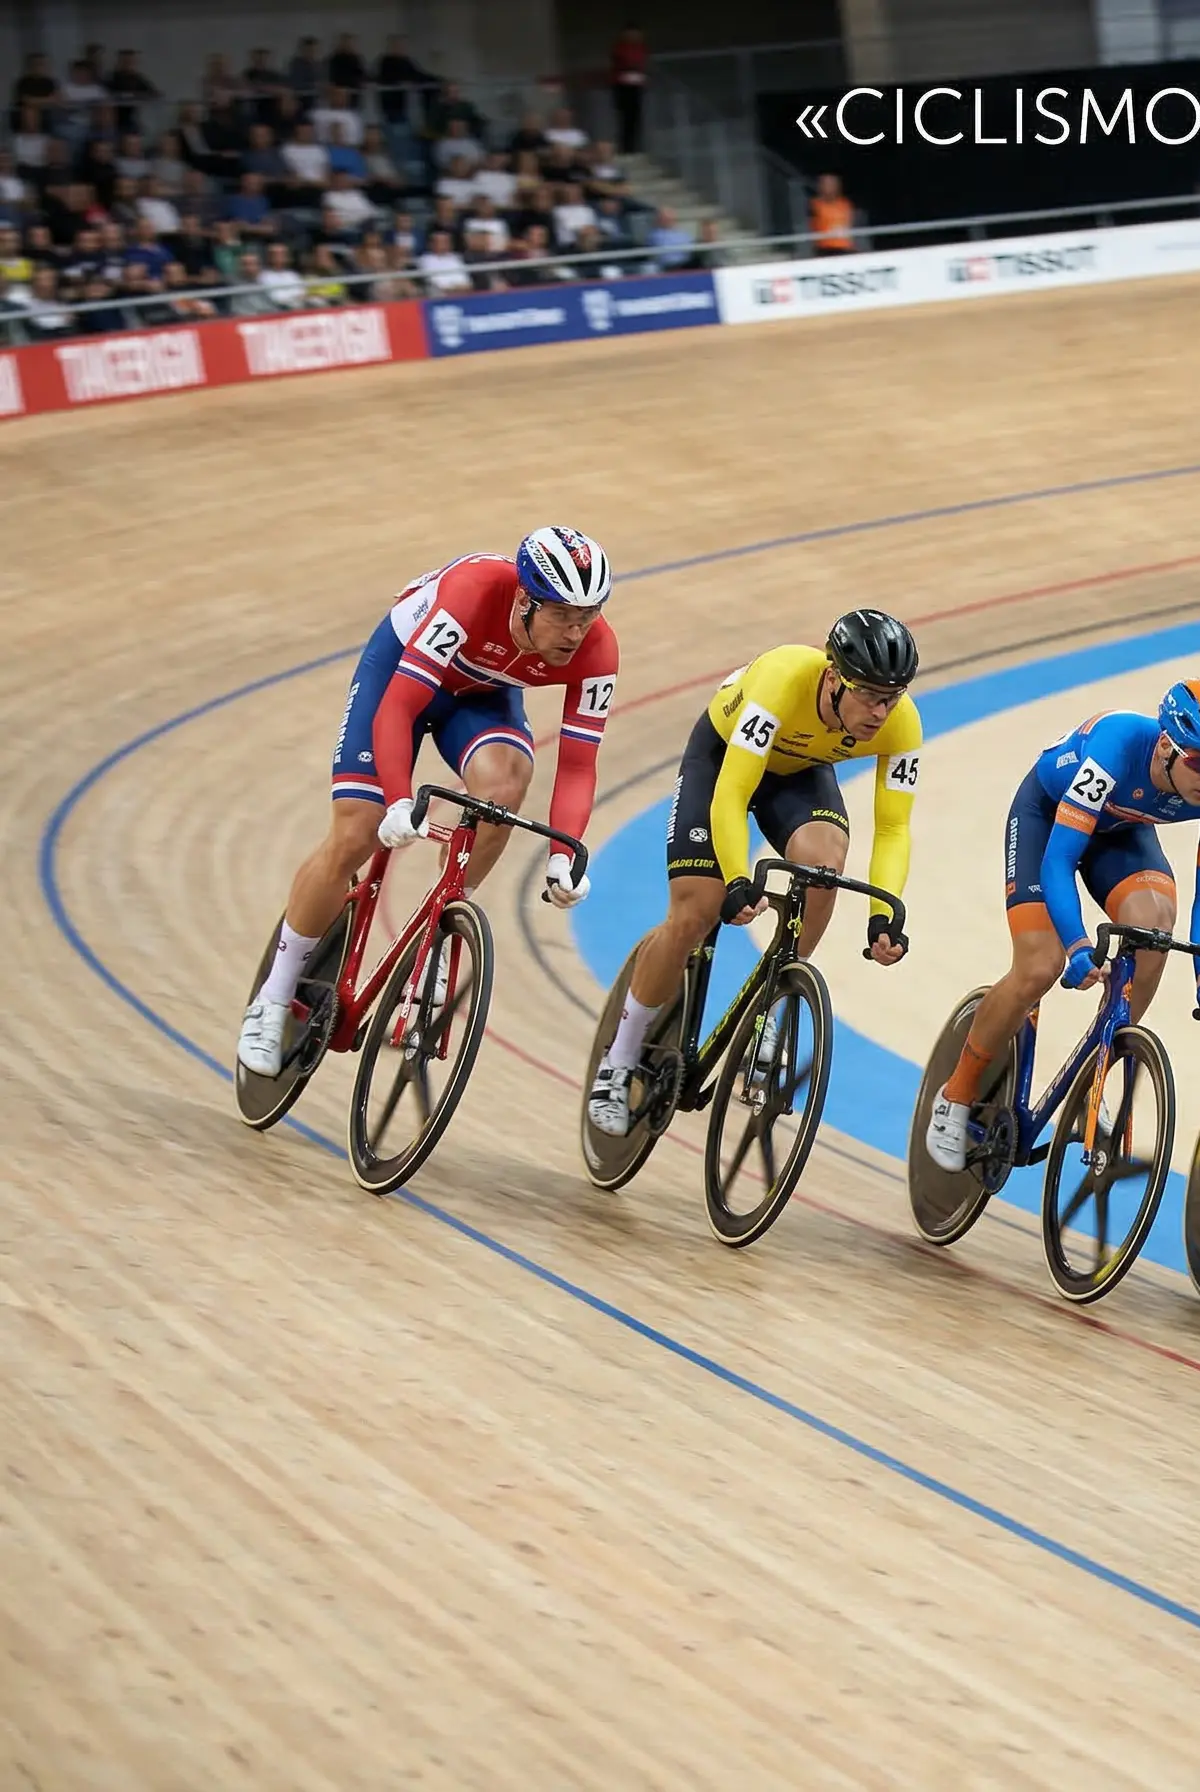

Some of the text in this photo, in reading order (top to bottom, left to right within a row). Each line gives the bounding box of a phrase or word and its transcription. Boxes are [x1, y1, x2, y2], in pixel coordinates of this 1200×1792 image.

[988, 245, 1098, 276] TISSOT
[793, 266, 897, 298] TISSOT
[426, 622, 460, 658] 12
[586, 683, 614, 711] 12
[740, 714, 775, 748] 45
[891, 757, 919, 786] 45
[1072, 768, 1108, 803] 23
